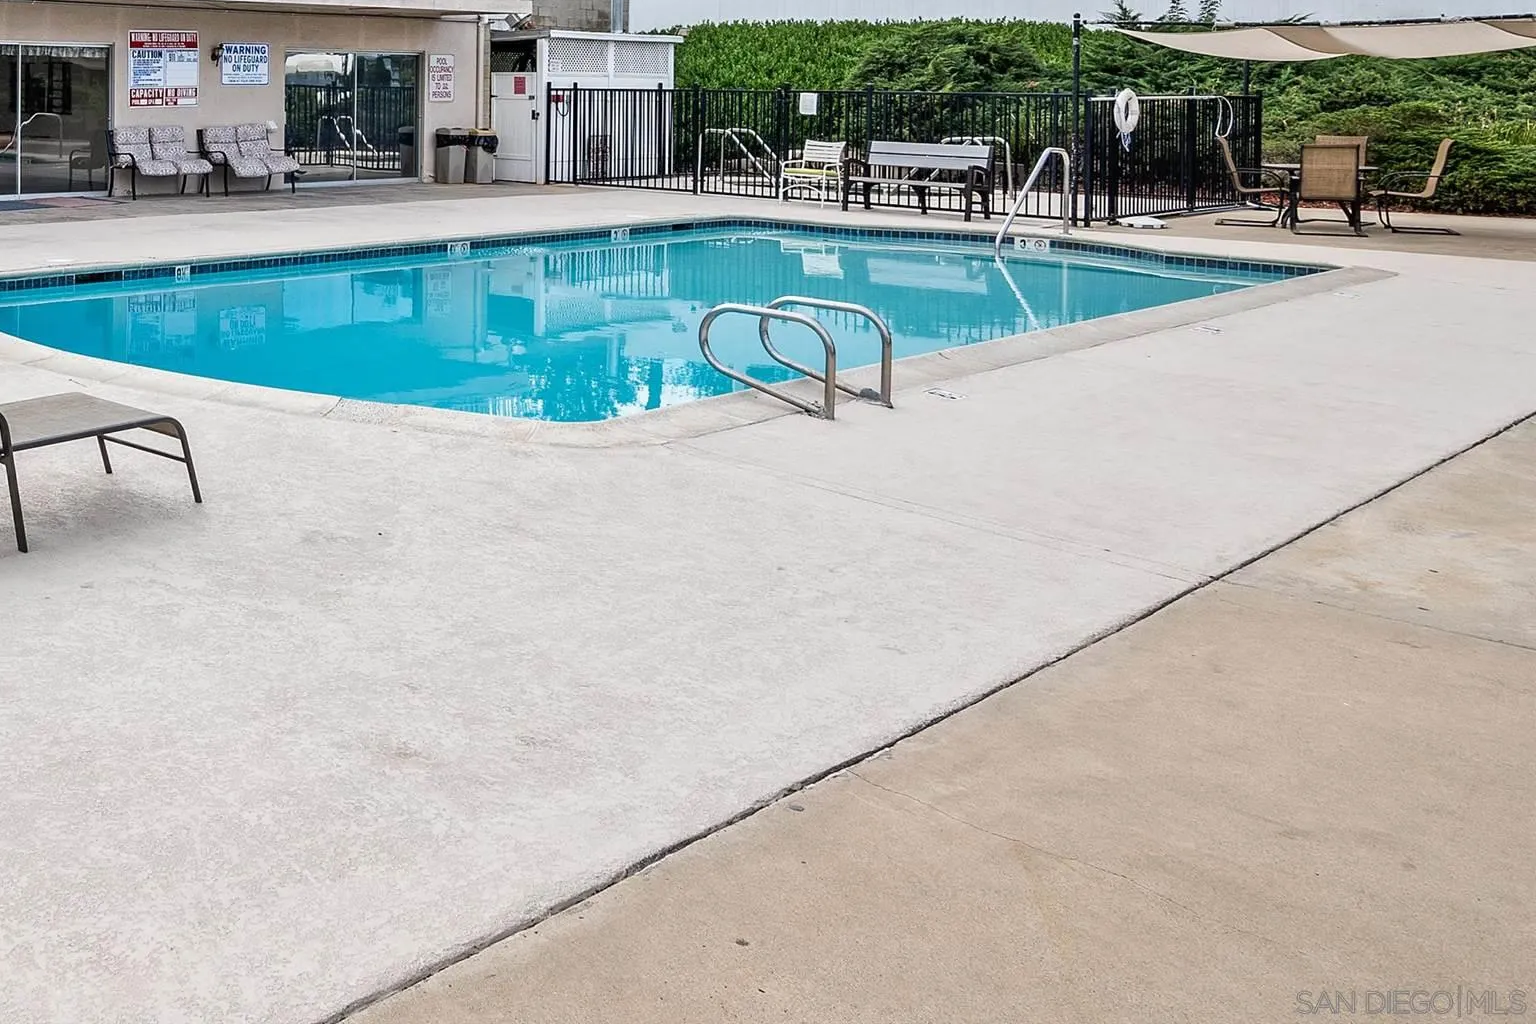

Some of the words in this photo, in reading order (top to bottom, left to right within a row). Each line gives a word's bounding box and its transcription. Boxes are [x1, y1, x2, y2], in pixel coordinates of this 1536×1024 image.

[132, 50, 162, 59] CAUTION
[225, 46, 266, 55] WARNING
[224, 55, 232, 63] NO
[234, 55, 268, 64] LIFEGUARD
[232, 64, 241, 72] ON
[243, 64, 259, 72] DUTY
[131, 89, 163, 98] CAPACITY
